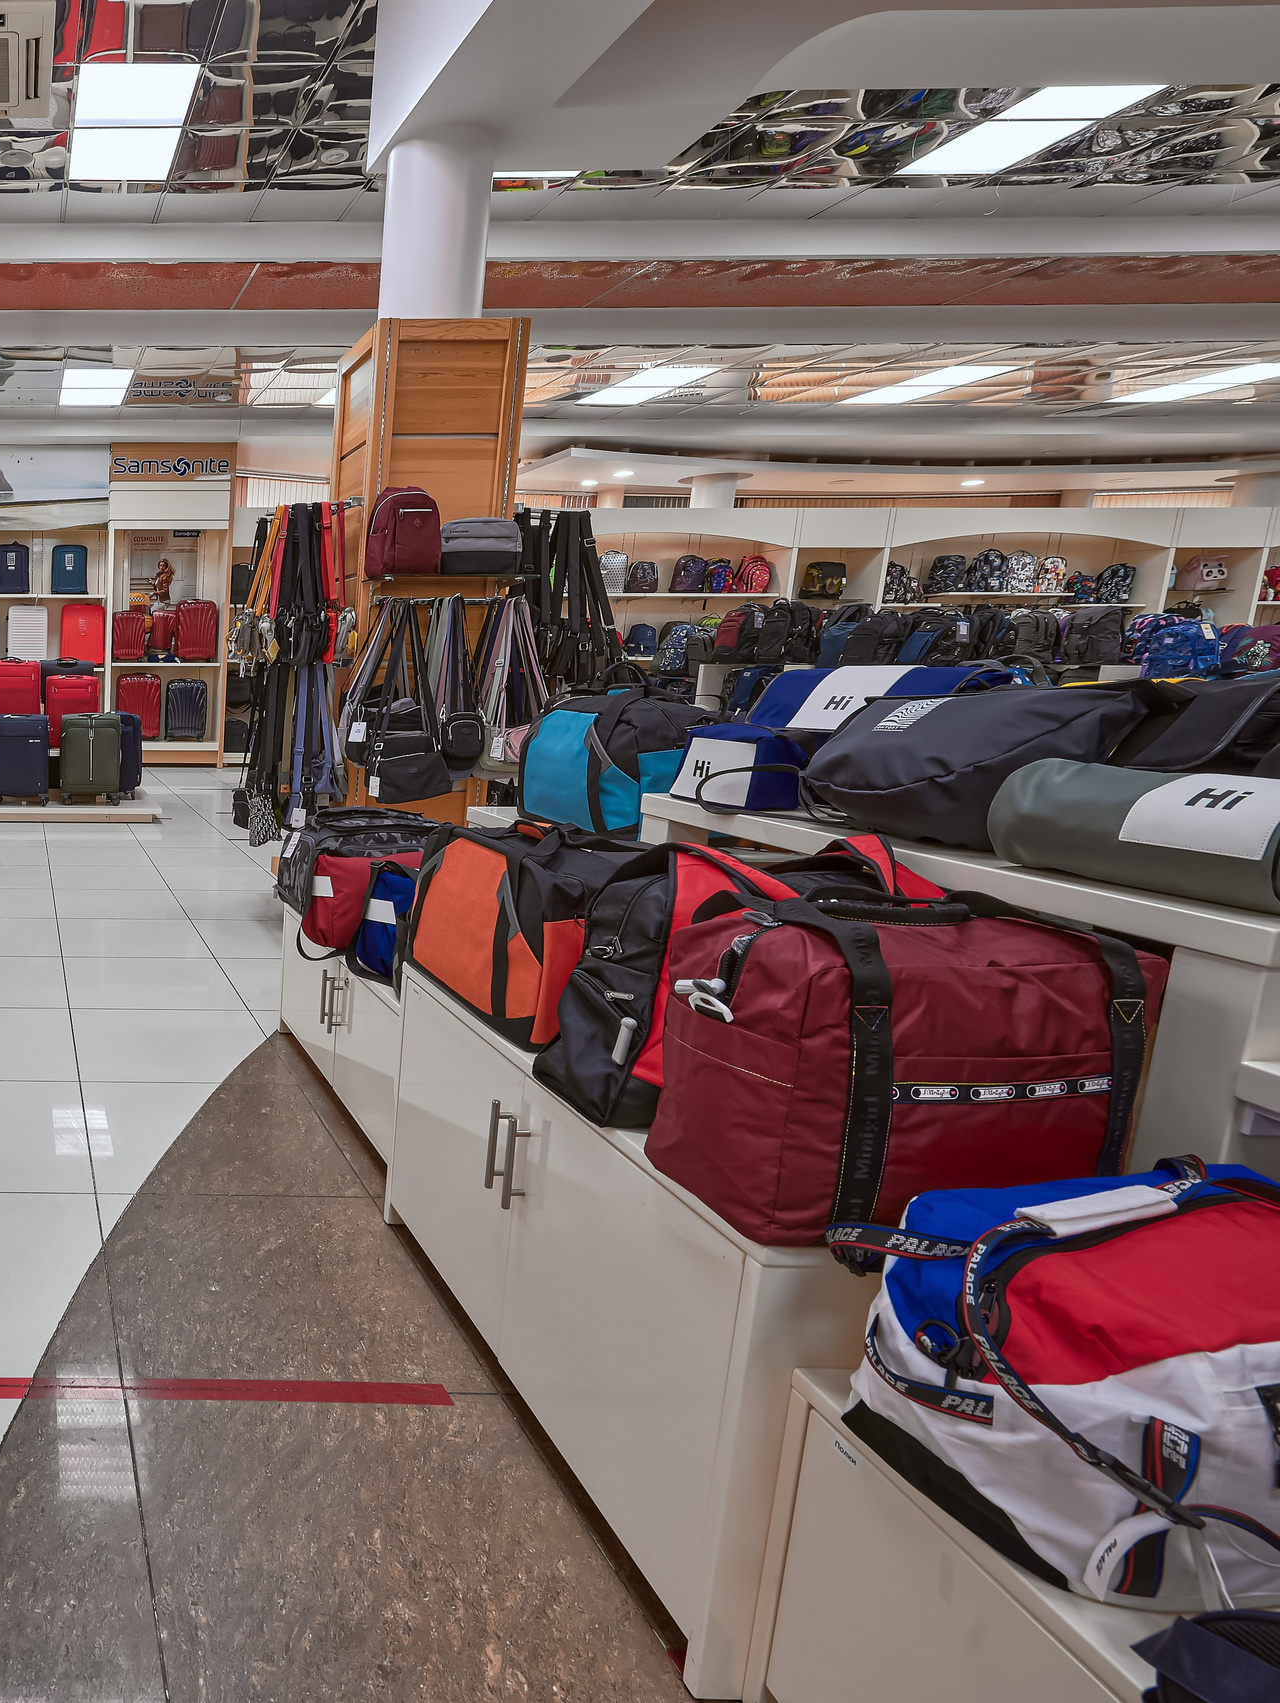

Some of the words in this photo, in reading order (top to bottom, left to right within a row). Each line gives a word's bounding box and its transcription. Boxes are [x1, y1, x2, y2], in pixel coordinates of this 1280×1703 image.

[113, 456, 230, 477] Samsonite
[823, 695, 854, 711] Hi
[693, 759, 712, 778] Hi
[1184, 787, 1255, 811] Hi
[966, 1243, 987, 1306] PALACE
[865, 1337, 909, 1393] PALACE
[973, 1332, 1045, 1413] PALACE
[834, 1440, 857, 1466] Полки
